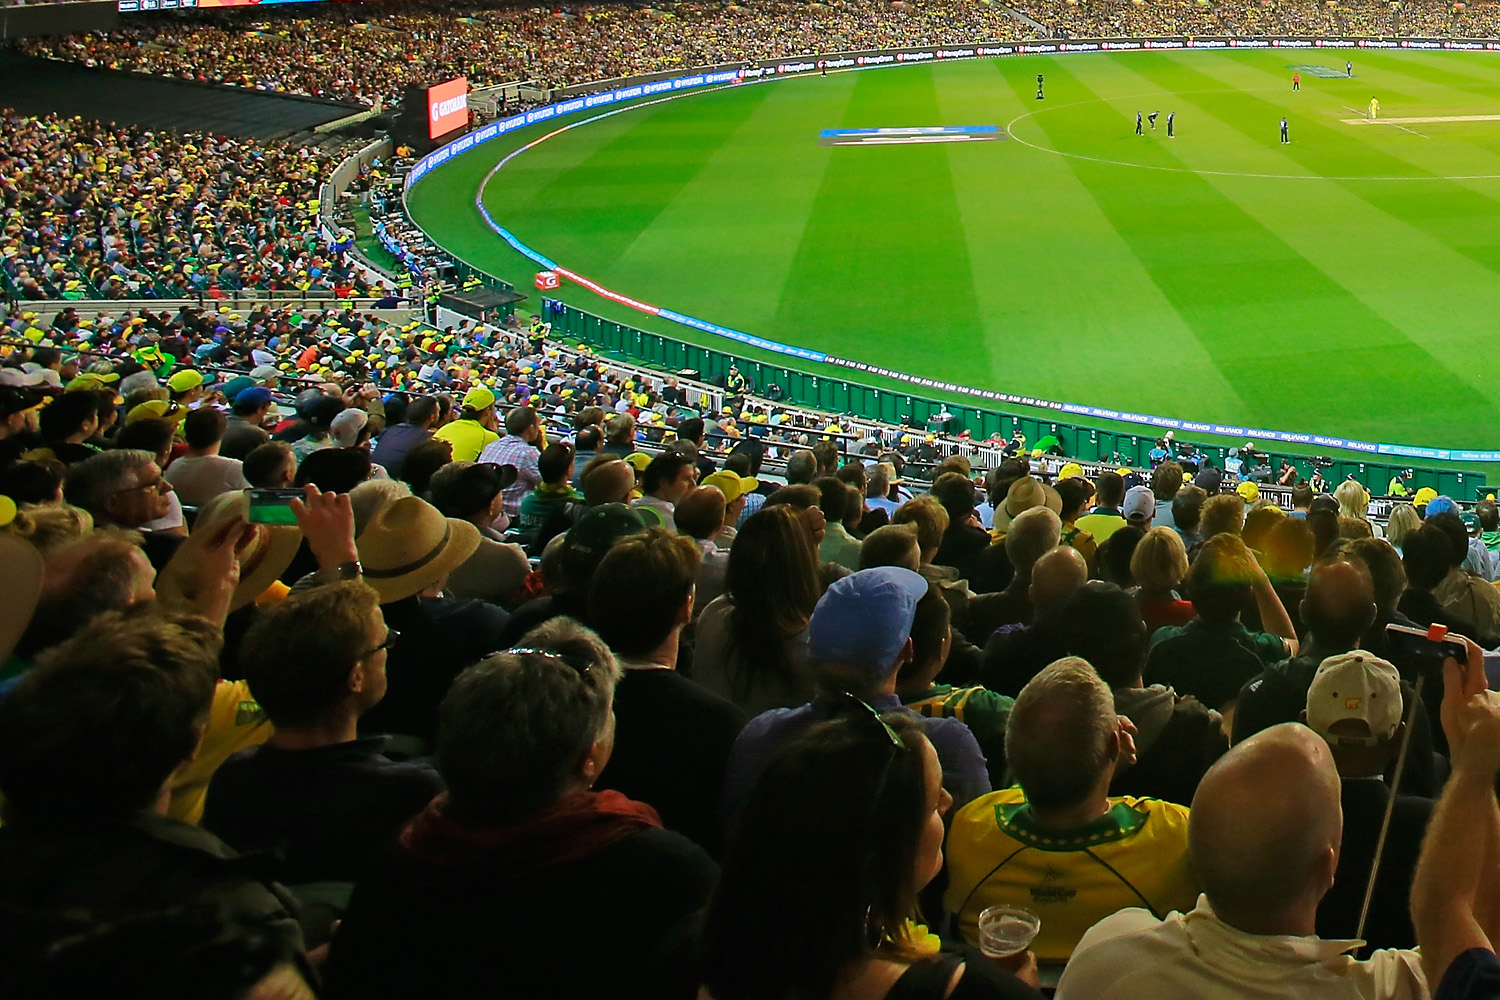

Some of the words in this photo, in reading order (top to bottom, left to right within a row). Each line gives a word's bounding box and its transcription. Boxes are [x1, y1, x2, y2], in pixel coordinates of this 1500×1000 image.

[1066, 43, 1098, 51] MoneyGram
[904, 52, 933, 60] MoneyGram
[943, 48, 973, 57] MoneyGram
[864, 55, 893, 64] MoneyGram
[784, 63, 814, 73] MoneyGram
[681, 77, 703, 86] HYUNDAI
[713, 72, 736, 81] HYUNDAI
[651, 82, 672, 92] HYUNDAI
[621, 88, 641, 98] HYUNDAI
[592, 94, 613, 105] HYUNDAI
[564, 100, 583, 112] HYUNDAI
[432, 103, 438, 121] G
[534, 107, 554, 120] HYUNDAI
[506, 116, 525, 129] HYUNDAI
[480, 126, 497, 141] HYUNDAI
[546, 276, 557, 286] G
